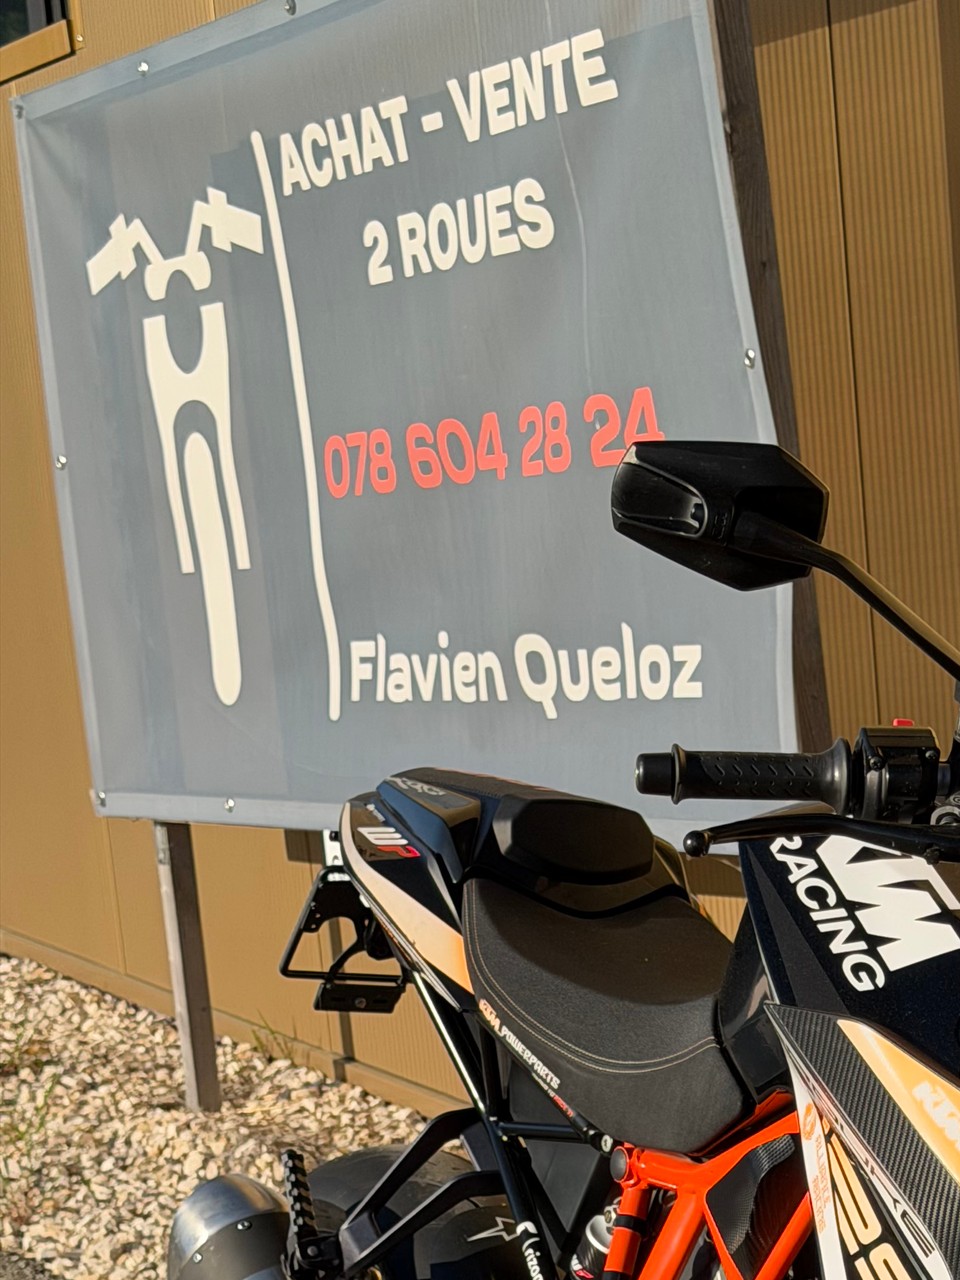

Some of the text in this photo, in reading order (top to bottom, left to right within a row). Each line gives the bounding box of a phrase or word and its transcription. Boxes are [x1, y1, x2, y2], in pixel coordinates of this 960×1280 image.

[280, 28, 619, 196] ACHAT - VENTE
[363, 177, 555, 286] 2 ROUES
[324, 386, 666, 499] 078 604 28 24
[350, 621, 703, 720] Flavien Queloz
[500, 1025, 560, 1089] POWERPARTS
